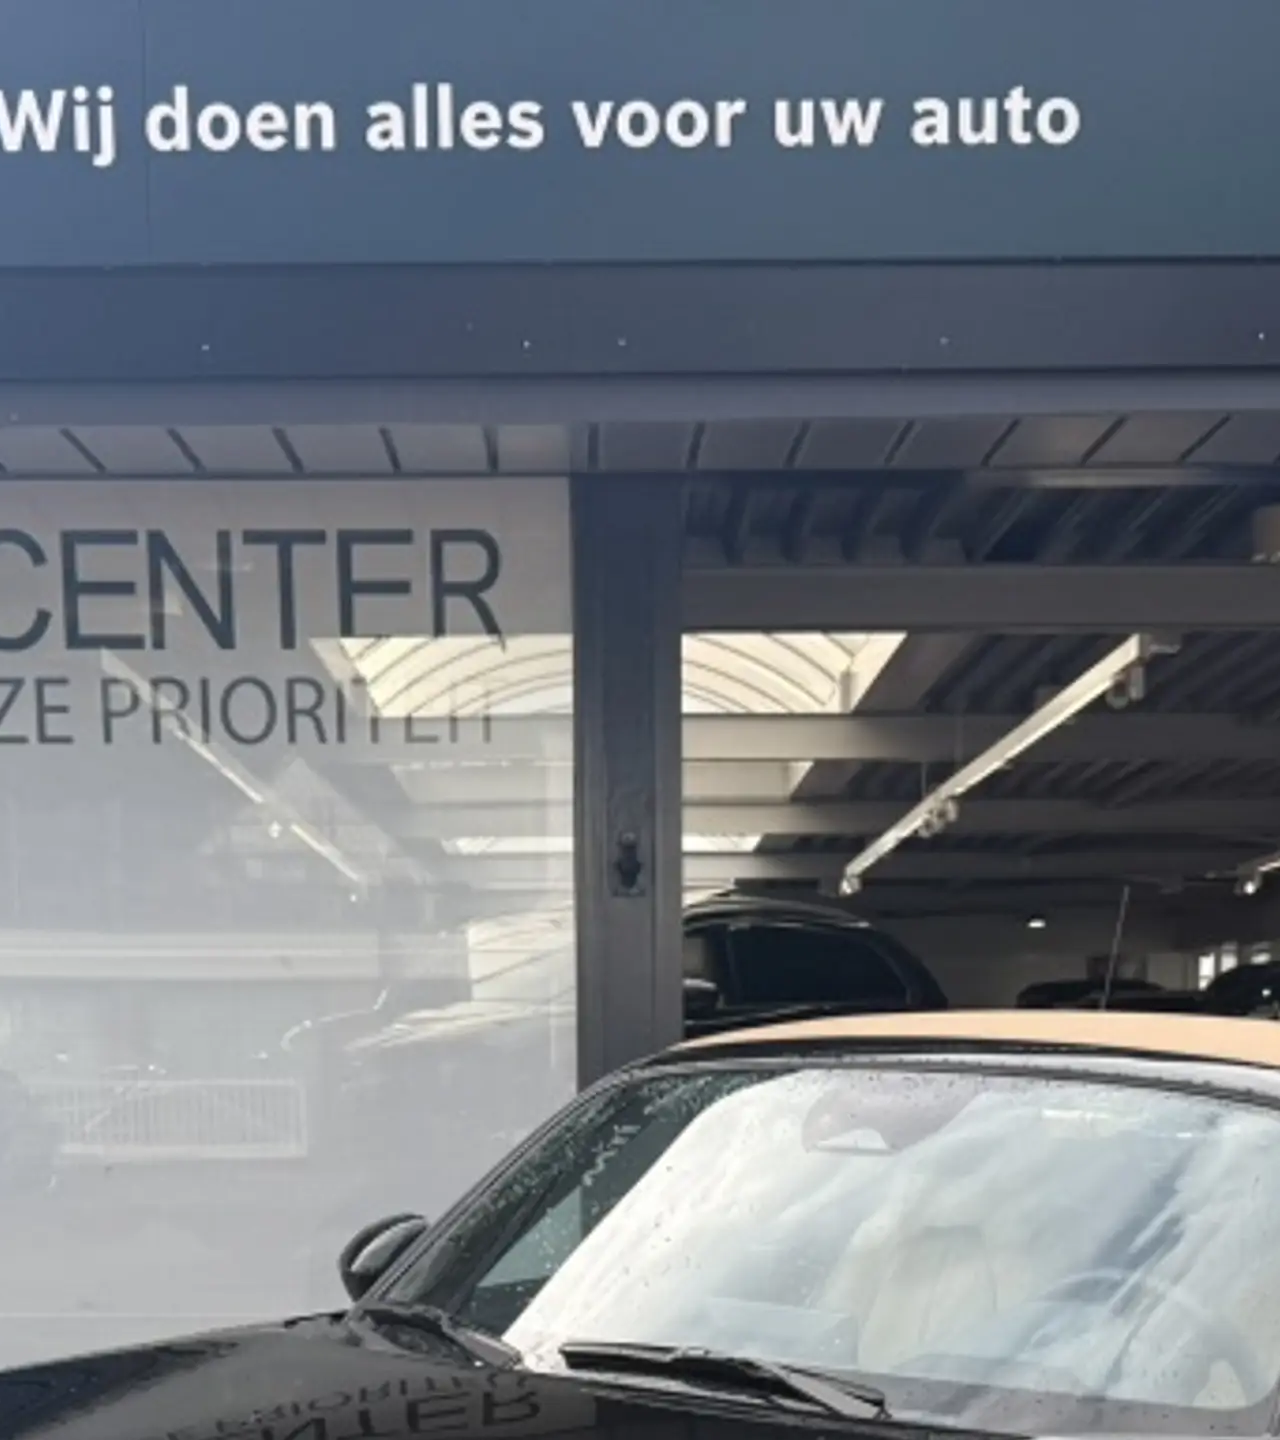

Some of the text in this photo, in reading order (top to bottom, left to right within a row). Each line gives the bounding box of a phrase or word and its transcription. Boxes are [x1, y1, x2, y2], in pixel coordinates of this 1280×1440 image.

[144, 84, 336, 152] doen
[364, 82, 544, 150] alles
[571, 97, 747, 149] voor
[774, 97, 884, 147] uw
[911, 85, 1081, 146] auto
